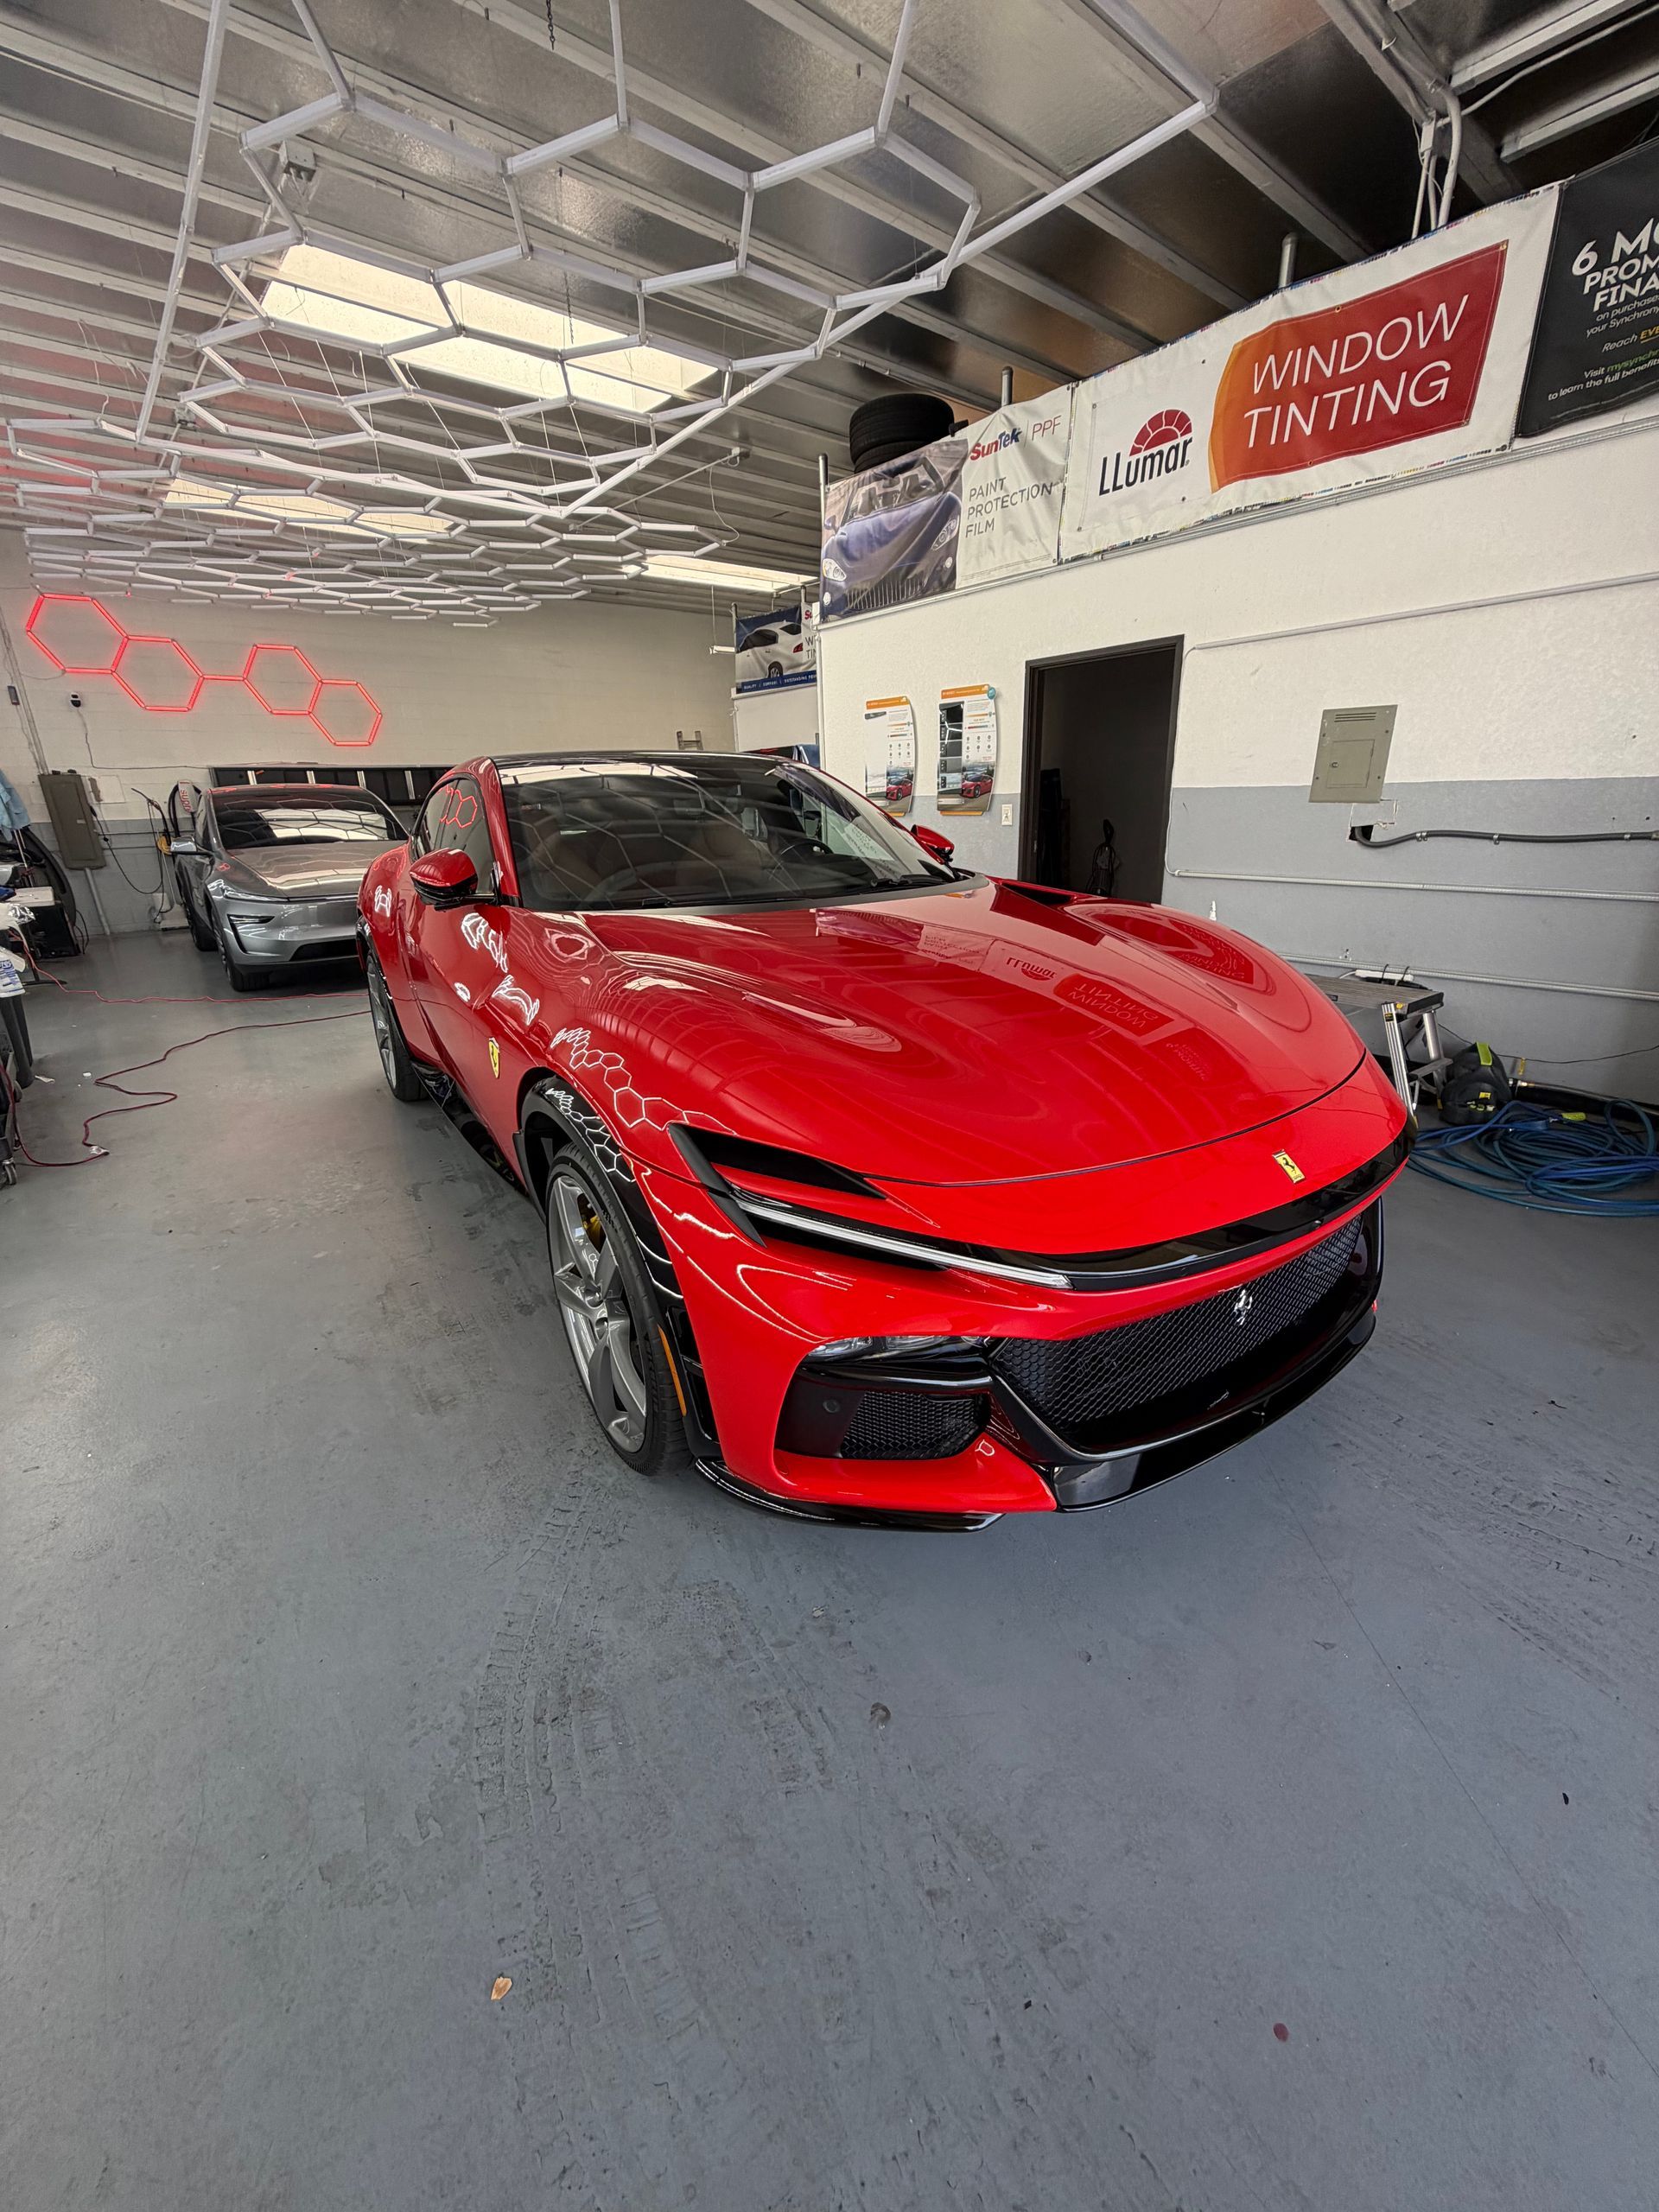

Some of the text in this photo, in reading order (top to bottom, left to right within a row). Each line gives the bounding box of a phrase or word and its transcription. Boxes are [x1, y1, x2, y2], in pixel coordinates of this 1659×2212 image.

[1572, 217, 1659, 276] 6 M
[1592, 271, 1659, 312] FINA
[1586, 322, 1609, 339] your
[1595, 312, 1610, 322] on
[1254, 294, 1469, 395] WINDOW
[1601, 333, 1638, 353] Reach
[1548, 392, 1559, 401] to
[1560, 383, 1585, 397] learn
[1586, 378, 1604, 390] the
[1604, 372, 1621, 385] full
[1584, 366, 1605, 379] Visit
[1244, 360, 1452, 448] TINTING
[969, 415, 1062, 461] SunTek PPF
[1099, 436, 1192, 496] LLumar
[968, 482, 1053, 520] PROTECTION
[969, 476, 1007, 502] PAINT
[965, 518, 995, 538] FILM
